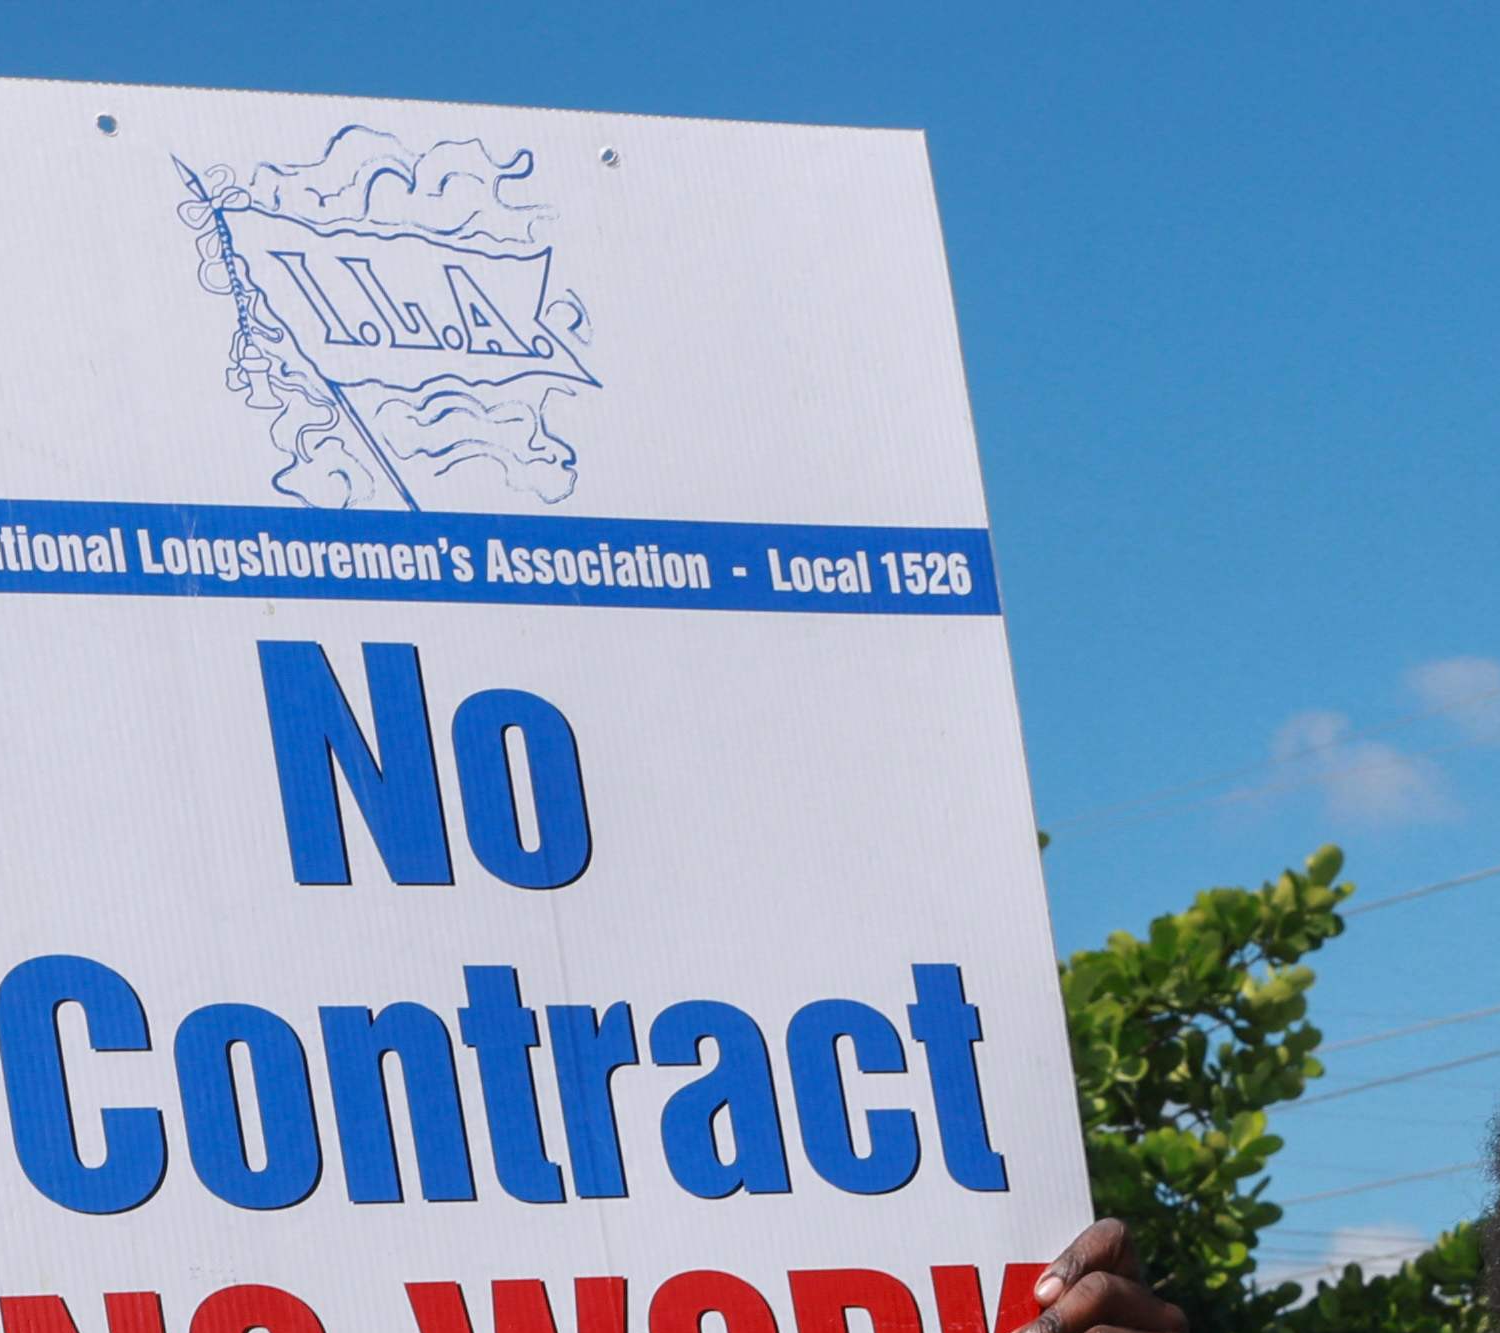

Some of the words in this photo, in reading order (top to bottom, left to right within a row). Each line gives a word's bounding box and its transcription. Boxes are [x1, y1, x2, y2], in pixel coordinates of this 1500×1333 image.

[267, 250, 553, 359] I.L.A.
[136, 527, 475, 583] Longshoremen's
[486, 538, 712, 590] Association
[767, 547, 872, 594] Local
[880, 551, 972, 596] 1526
[256, 639, 593, 890] No
